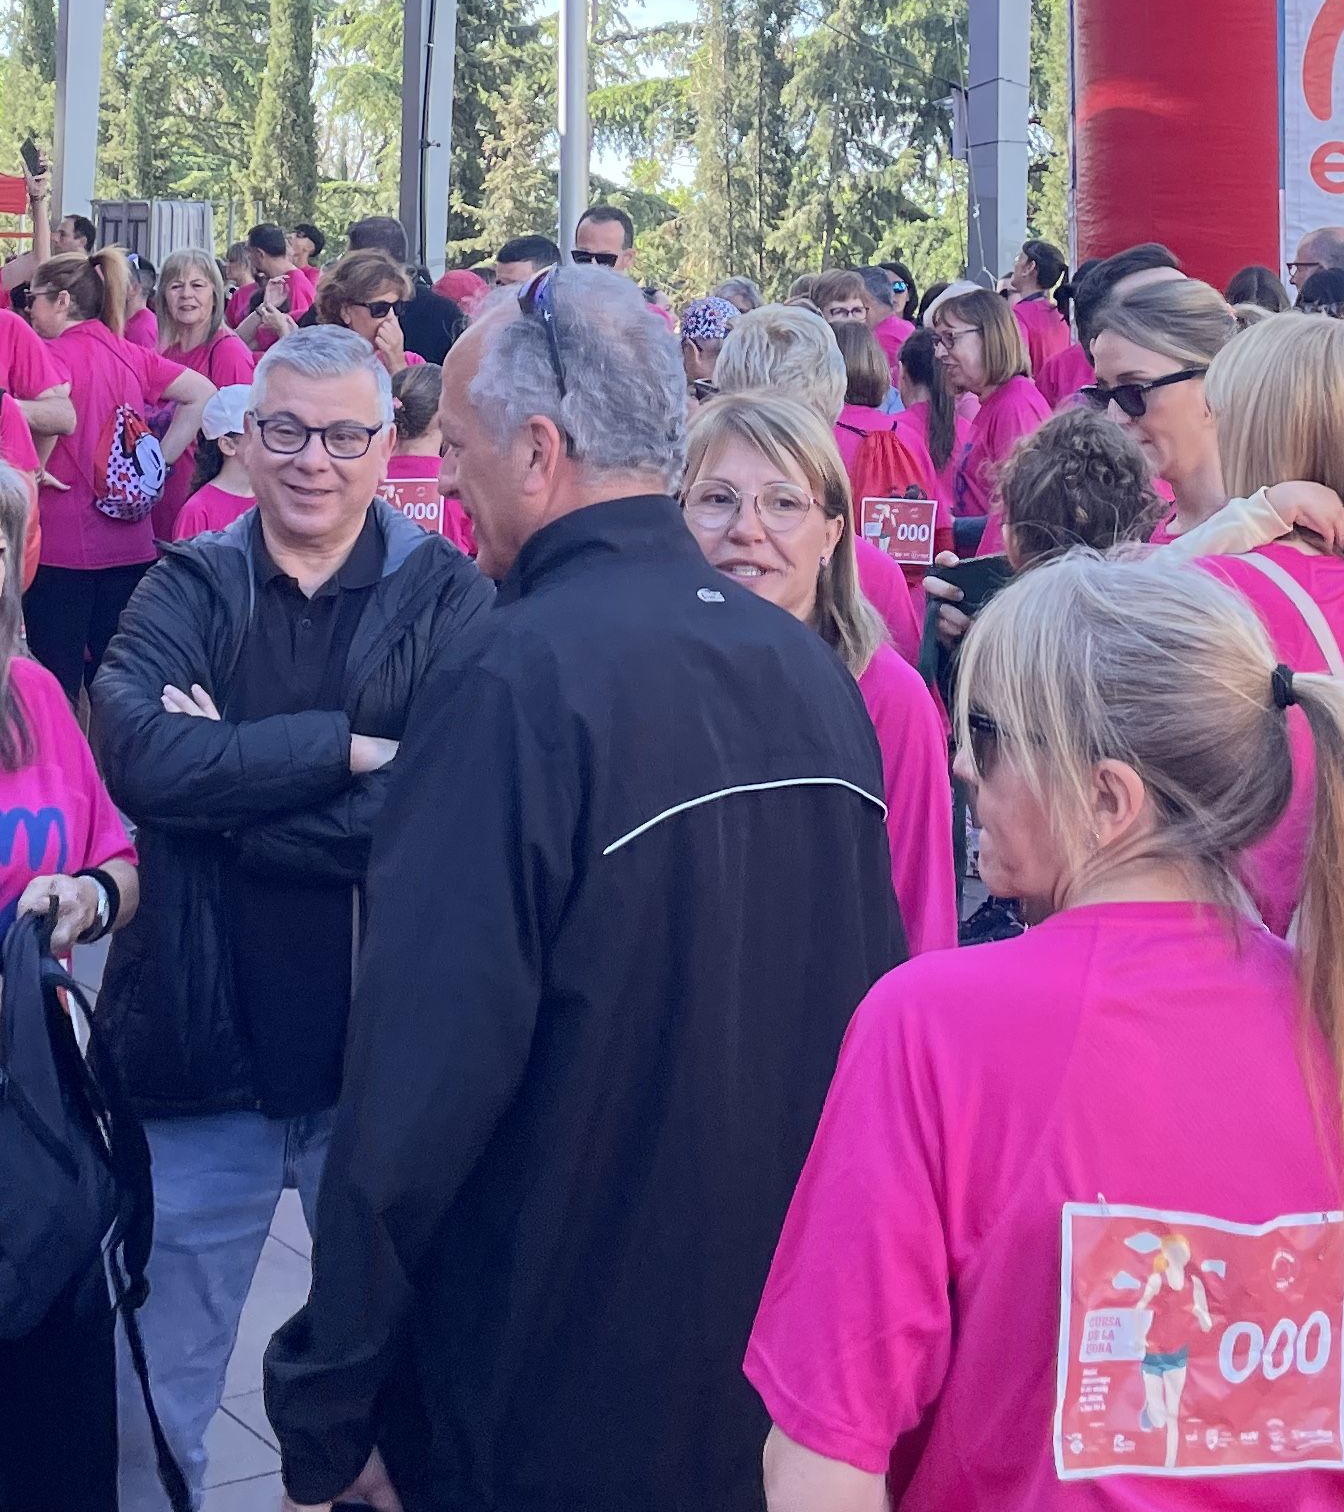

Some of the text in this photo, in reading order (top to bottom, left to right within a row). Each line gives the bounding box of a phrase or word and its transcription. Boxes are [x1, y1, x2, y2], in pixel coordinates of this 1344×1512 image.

[403, 502, 439, 520] 000
[897, 523, 930, 542] 000
[1218, 1310, 1332, 1384] 000
